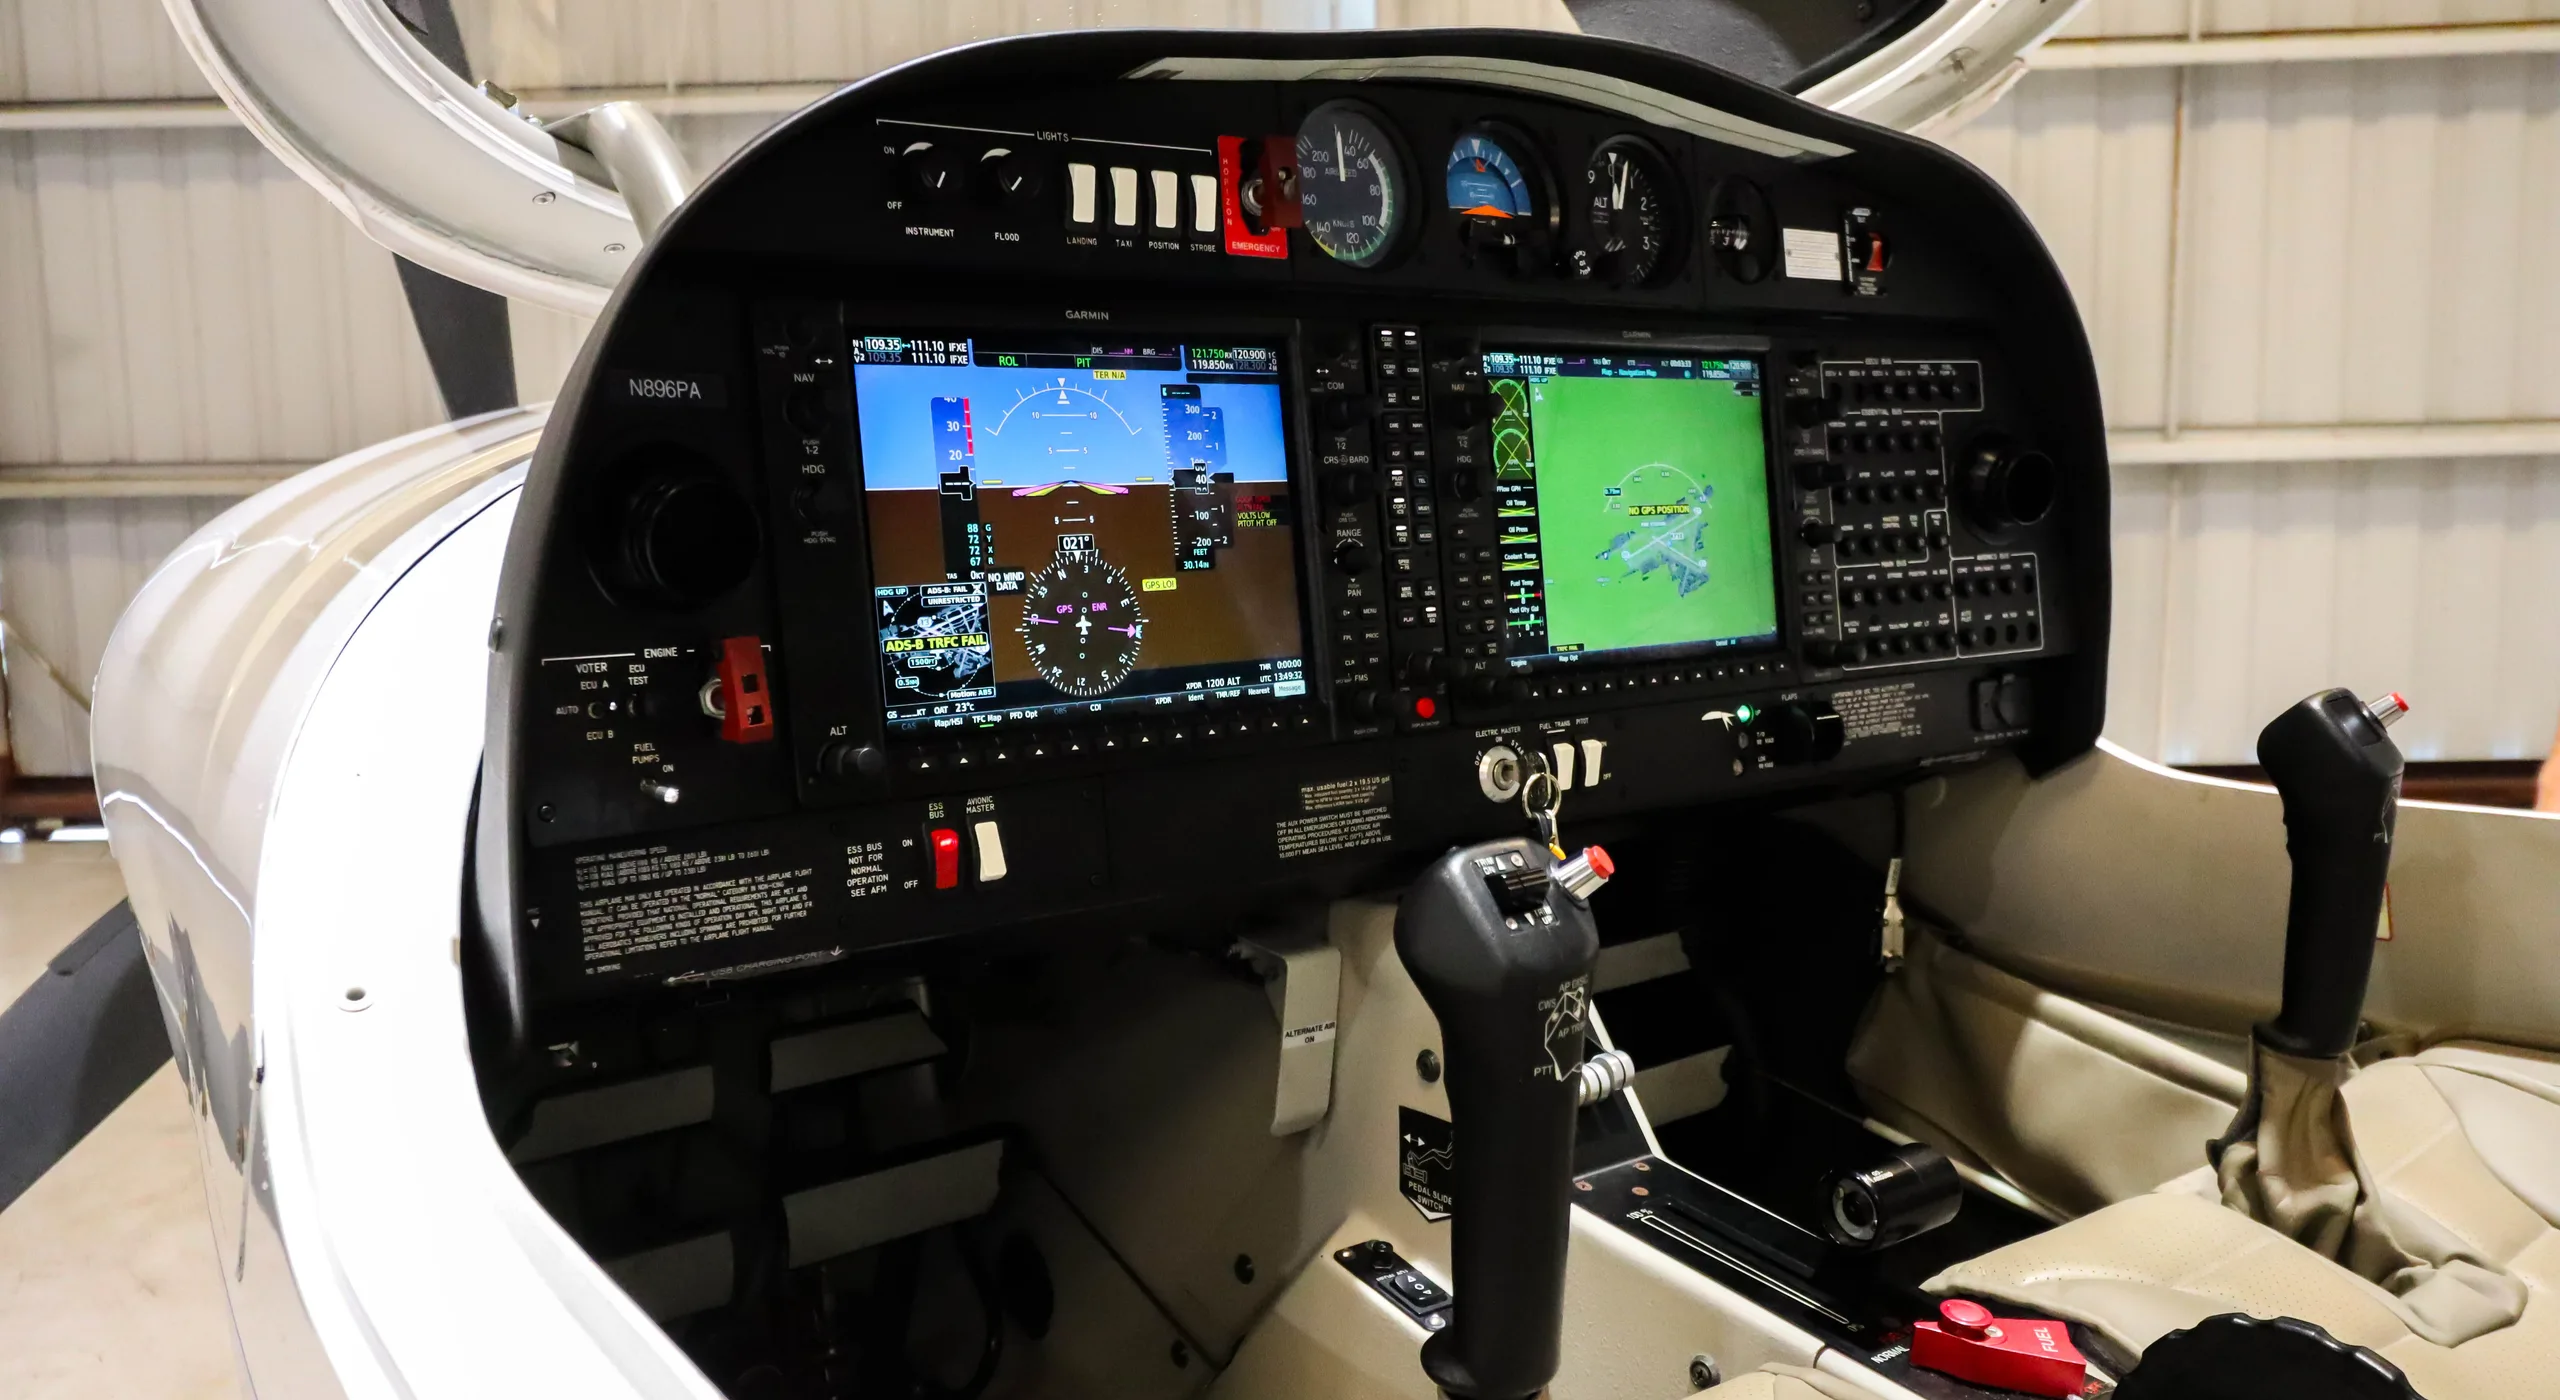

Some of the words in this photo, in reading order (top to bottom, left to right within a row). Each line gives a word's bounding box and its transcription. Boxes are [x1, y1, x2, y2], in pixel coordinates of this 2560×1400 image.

[1037, 131, 1069, 142] LIGHTS
[884, 146, 895, 155] ON
[1344, 146, 1356, 156] 40
[1312, 151, 1329, 162] 200
[1357, 158, 1369, 170] 60
[1302, 167, 1316, 178] 180
[1370, 185, 1380, 196] 80
[1302, 194, 1316, 205] 160
[1594, 197, 1607, 208] ALT
[887, 201, 902, 210] OFF
[1362, 215, 1375, 226] 100
[905, 227, 954, 237] INSTRUMENT
[1316, 222, 1330, 233] 140
[995, 232, 1020, 242] FLOOD
[1066, 236, 1098, 246] LANDING
[1346, 232, 1359, 244] 120
[1115, 239, 1133, 248] TAXI
[1148, 241, 1179, 251] POSITION
[1190, 243, 1216, 252] STROBE
[1231, 241, 1280, 253] EMERGENCY
[1065, 310, 1109, 321] GARMIN
[867, 339, 900, 351] 109.35
[911, 341, 944, 352] 111.10
[949, 342, 967, 353] IFXE
[1192, 348, 1224, 359] 121.750
[912, 353, 945, 364] 111.10
[950, 355, 968, 365] IFXE
[999, 356, 1018, 367] ROL
[1076, 357, 1091, 368] PIT
[1519, 356, 1541, 365] 111.10
[1192, 359, 1225, 370] 119.850
[1094, 370, 1110, 380] TER
[1111, 370, 1126, 380] N/A
[1520, 366, 1542, 374] 111.10
[1619, 369, 1646, 377] Navigation
[794, 374, 815, 383] NAV
[629, 378, 701, 399] N896PA
[1327, 382, 1344, 390] COM
[1185, 404, 1200, 415] 300
[947, 421, 960, 432] 30
[1187, 431, 1202, 441] 200
[949, 450, 962, 460] 20
[1349, 456, 1369, 464] BARO
[802, 465, 825, 474] HDG
[1629, 507, 1639, 516] NO
[1641, 506, 1655, 515] GPS
[1657, 505, 1689, 515] POSITION
[967, 524, 979, 533] 88
[1336, 529, 1361, 537] RANGE
[968, 535, 979, 544] 72
[969, 546, 980, 555] 72
[970, 557, 981, 566] 67
[988, 573, 1001, 583] NO
[1003, 571, 1025, 582] WIND
[996, 582, 1018, 591] DATA
[877, 588, 893, 596] HDG
[1347, 589, 1362, 597] PAN
[928, 596, 980, 605] UNRESTRICTED
[1056, 605, 1073, 614] GPS
[1092, 602, 1107, 611] ENR
[885, 639, 924, 652] ADS-B
[927, 637, 959, 649] TRFC
[961, 635, 986, 647] FAIL
[644, 647, 678, 658] ENGINE
[576, 663, 608, 673] VOTER
[629, 665, 645, 673] ECU
[1277, 660, 1302, 669] 0:00:00
[1475, 662, 1486, 670] ALT
[628, 676, 648, 686] TEST
[1260, 674, 1272, 683] UTC
[1274, 671, 1302, 681] 13:49:32
[1354, 674, 1368, 682] FMS
[580, 681, 597, 690] ECU
[602, 680, 609, 689] A
[1186, 682, 1202, 690] XPDR
[1206, 679, 1224, 688] 1200
[1227, 677, 1241, 686] ALT
[1248, 687, 1270, 695] Nearest
[1155, 697, 1172, 705] XPDR
[1188, 693, 1204, 701] Ident
[1781, 693, 1797, 701] FLAPS
[556, 706, 579, 715] AUTO
[934, 706, 948, 715] OAT
[1009, 711, 1023, 720] PFD
[1024, 710, 1038, 720] Opt
[935, 718, 963, 728] Map/HSI
[987, 715, 1002, 725] Map
[586, 731, 603, 740] ECU
[608, 730, 614, 739] B
[829, 725, 847, 736] ALT
[1475, 728, 1498, 738] ELECTRIC
[1501, 726, 1521, 735] MASTER
[634, 743, 655, 752] FUEL
[632, 754, 660, 764] PUMPS
[967, 796, 993, 805] AVIONIC
[966, 804, 995, 814] MASTER
[929, 811, 944, 819] BUS
[1299, 818, 1318, 826] POWER
[1319, 815, 1338, 823] SWITCH
[1339, 812, 1353, 820] MUST
[1303, 822, 1338, 833] EMERGENCIES
[902, 839, 913, 847] ON
[847, 846, 862, 854] ESS
[867, 843, 882, 851] BUS
[848, 856, 863, 865] NOT
[868, 854, 883, 862] FOR
[851, 865, 882, 875] NORMAL
[846, 874, 889, 887] OPERATION
[904, 880, 918, 889] OFF
[851, 889, 866, 897] SEE
[871, 885, 887, 894] AFM
[1559, 981, 1571, 992] AP
[1538, 999, 1556, 1011] CWS
[1285, 1025, 1323, 1039] ALTERNATE
[1324, 1022, 1335, 1030] AIR
[1558, 1027, 1570, 1039] AP
[1304, 1035, 1315, 1044] ON
[1534, 1066, 1554, 1077] PTT
[1409, 1181, 1430, 1197] PEDAL
[1432, 1189, 1452, 1205] SLIDE
[1417, 1195, 1444, 1212] SWITCH
[1626, 1211, 1644, 1220] 100
[2034, 1326, 2059, 1353] FUEL
[1870, 1345, 1910, 1364] NORMAL
